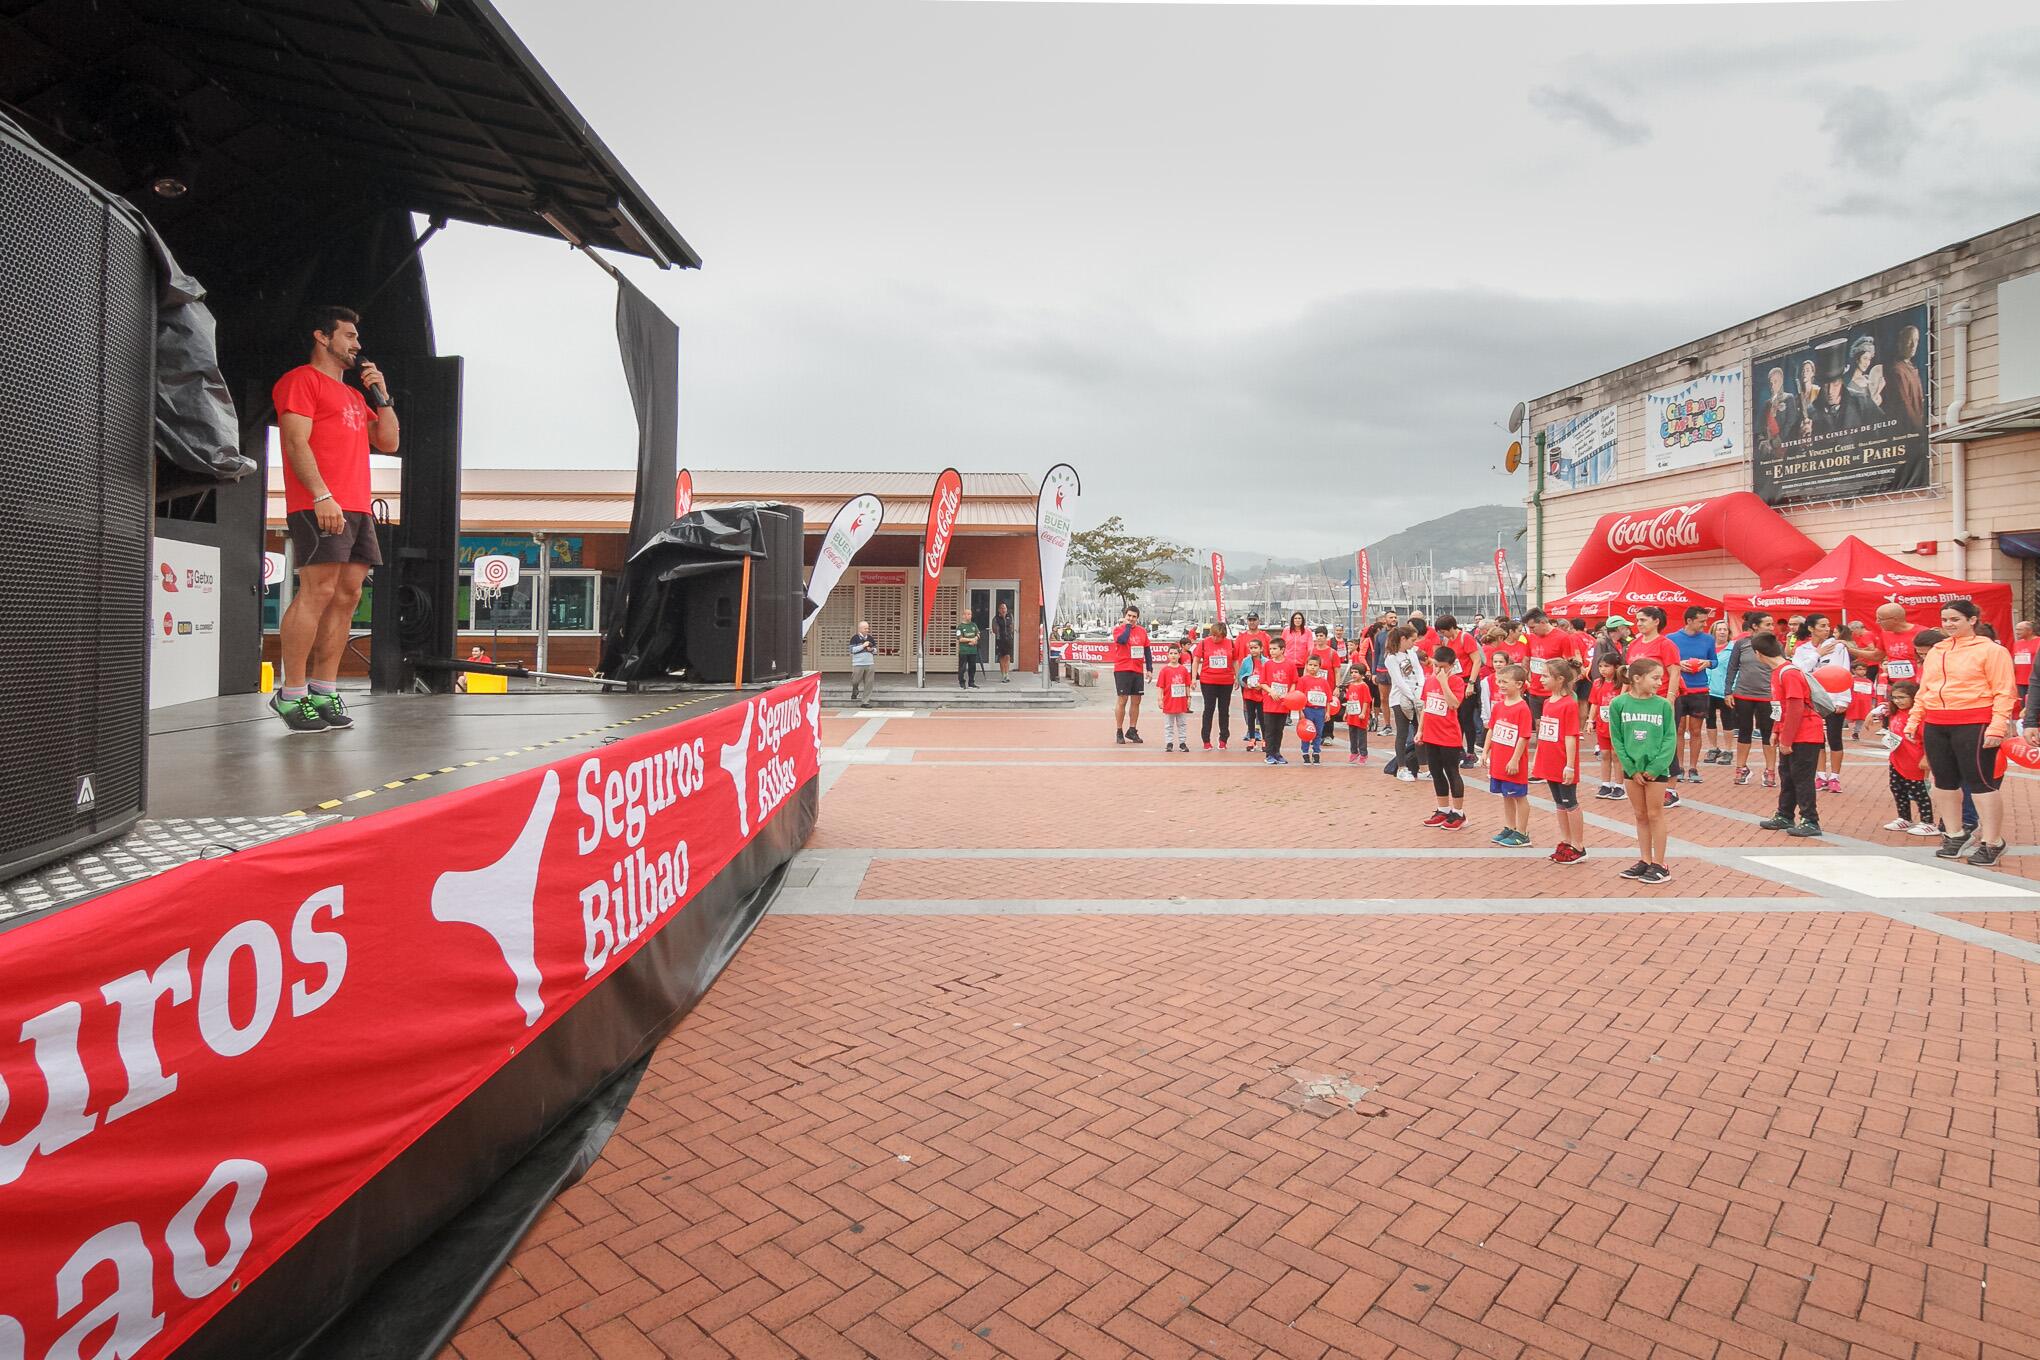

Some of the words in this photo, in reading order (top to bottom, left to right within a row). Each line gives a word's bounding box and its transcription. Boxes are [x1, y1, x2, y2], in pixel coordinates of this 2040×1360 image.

[1781, 437, 1812, 448] ESTRENO
[1825, 429, 1848, 439] CINES
[1873, 419, 1898, 431] JULIO
[1773, 455, 1851, 479] EMPERADOR
[1862, 444, 1907, 465] PARIS
[926, 482, 959, 578] Coca-Cola
[1044, 515, 1070, 532] BUEN
[1607, 502, 1708, 554] Coca-Cola
[832, 532, 853, 557] BUEN
[194, 569, 214, 585] Getxo
[1625, 591, 1689, 603] Coca-Cola
[1756, 597, 1785, 607] Seguros
[1786, 596, 1811, 606] Bilbao
[1898, 595, 1938, 606] Seguros
[1938, 593, 1973, 603] Bilbao
[1071, 643, 1110, 654] Seguros
[1072, 652, 1103, 661] Bilbao
[757, 692, 803, 753] Seguros
[1621, 712, 1664, 727] TRAINING
[577, 737, 705, 856] Seguros
[757, 755, 798, 824] Bilbao
[578, 840, 689, 982] Bilbao
